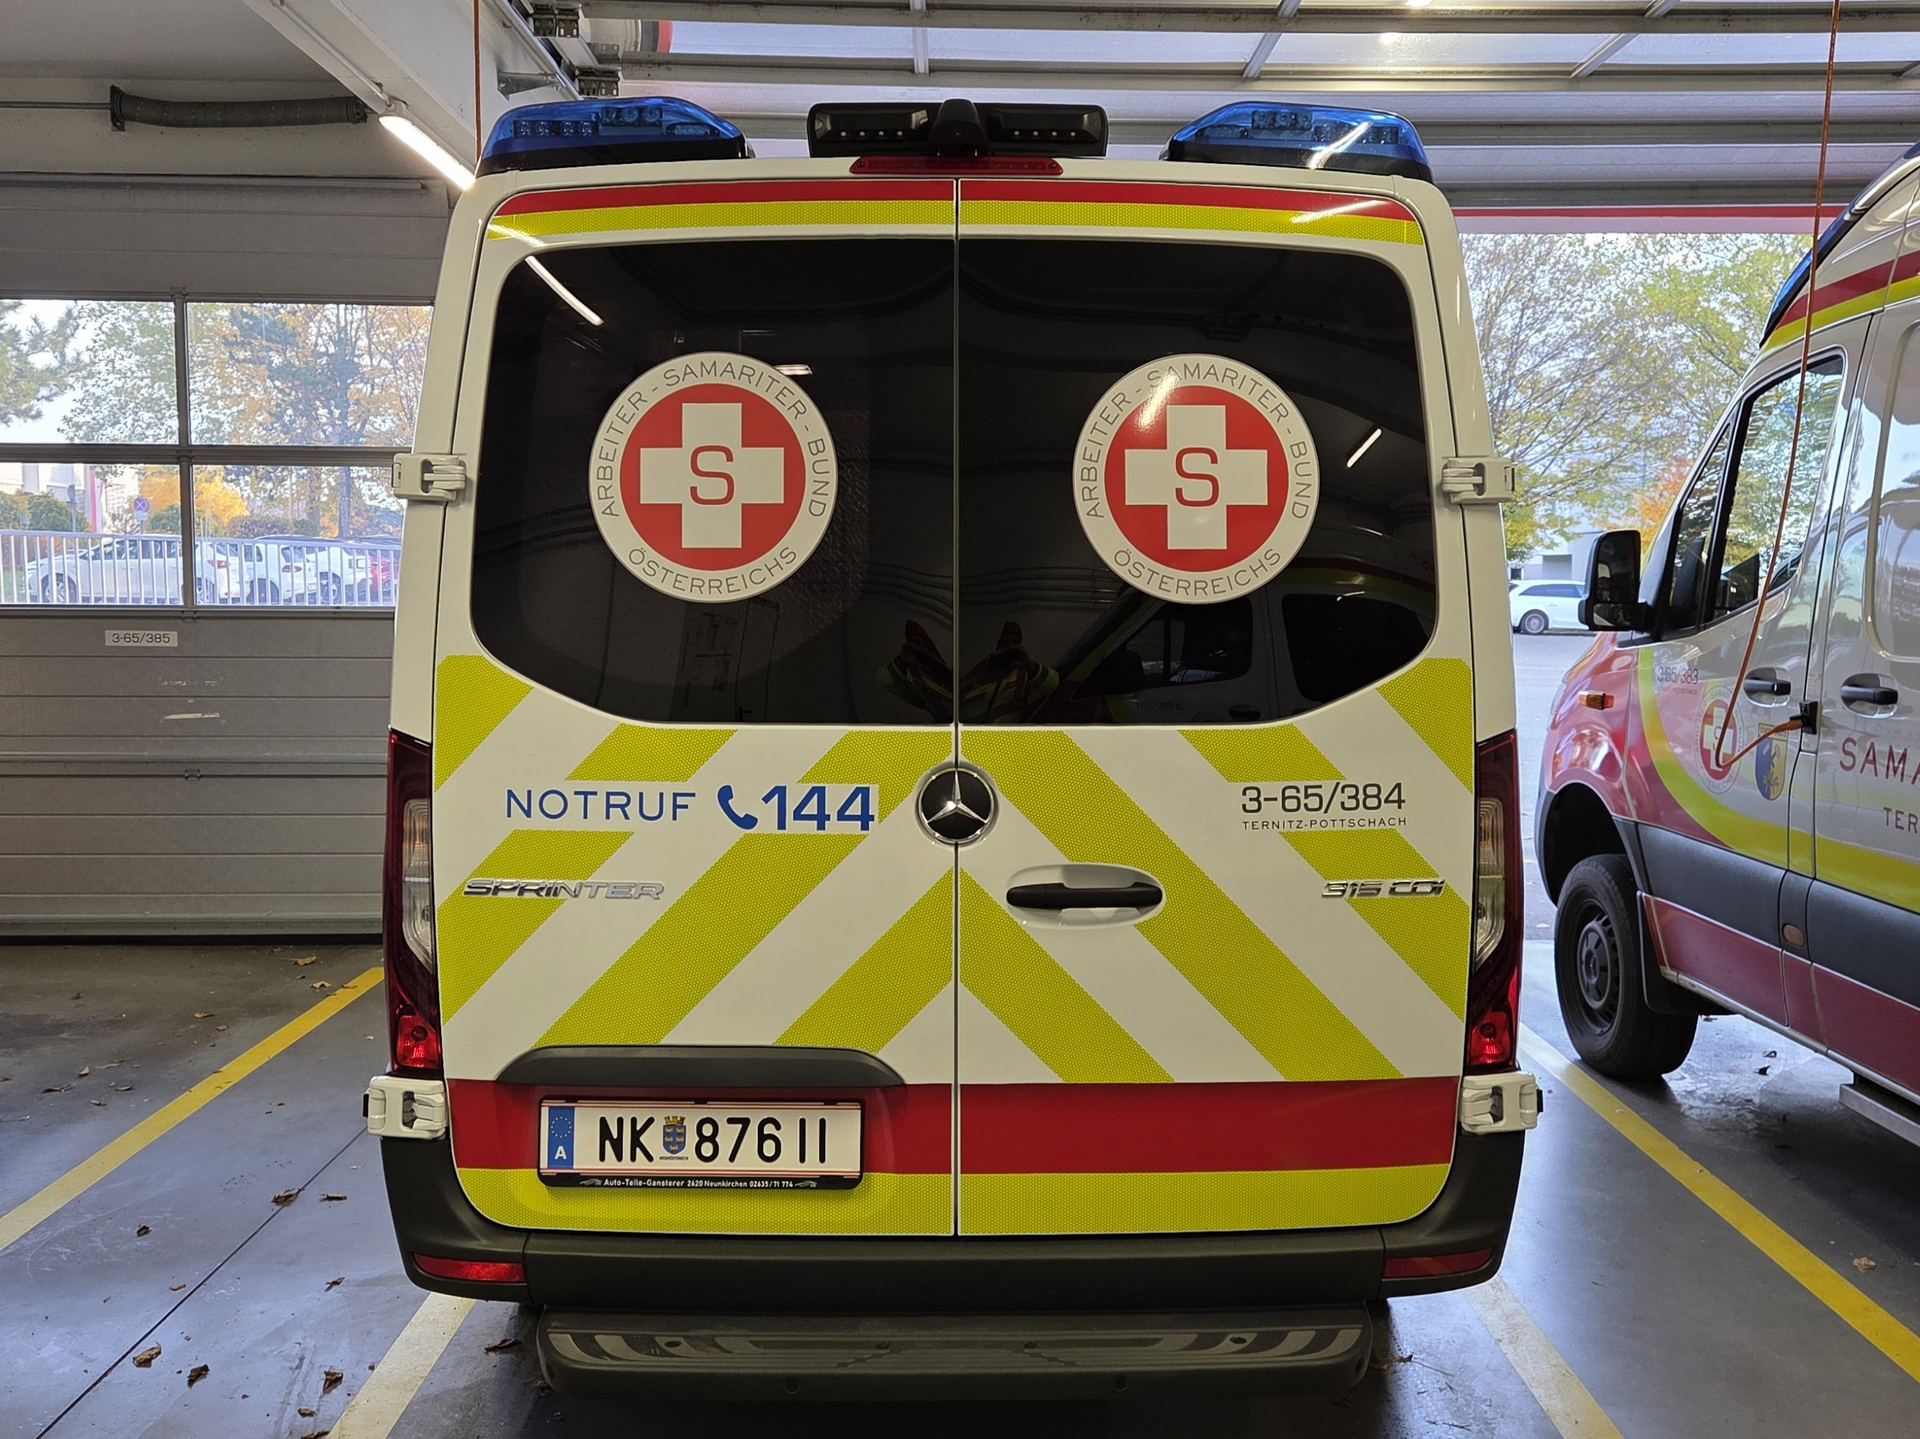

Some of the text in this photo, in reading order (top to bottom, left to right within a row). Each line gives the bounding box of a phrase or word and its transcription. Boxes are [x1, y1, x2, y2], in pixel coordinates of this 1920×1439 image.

[596, 360, 830, 517] ARBEITER SAMARITER BUND
[1081, 363, 1312, 519] ARBEITER SAMARITER BUND
[690, 445, 734, 505] S
[1175, 447, 1219, 507] S
[629, 547, 797, 595] ÖSTERREICHS
[1114, 548, 1281, 597] ÖSTERREICHS
[112, 633, 170, 644] 3-65/385
[507, 785, 875, 831] NOTRUF 144
[1241, 782, 1406, 814] 3-65/384
[1241, 817, 1407, 830] TERNITZ-POTTSCHACH
[464, 880, 664, 900] SPRINTER
[1321, 880, 1382, 899] 315
[554, 1145, 567, 1161] A
[599, 1116, 654, 1163] NK
[603, 1178, 685, 1188] Auto-Teile-Gansterer
[687, 1179, 703, 1188] 2620
[704, 1179, 748, 1189] Neunkirchen
